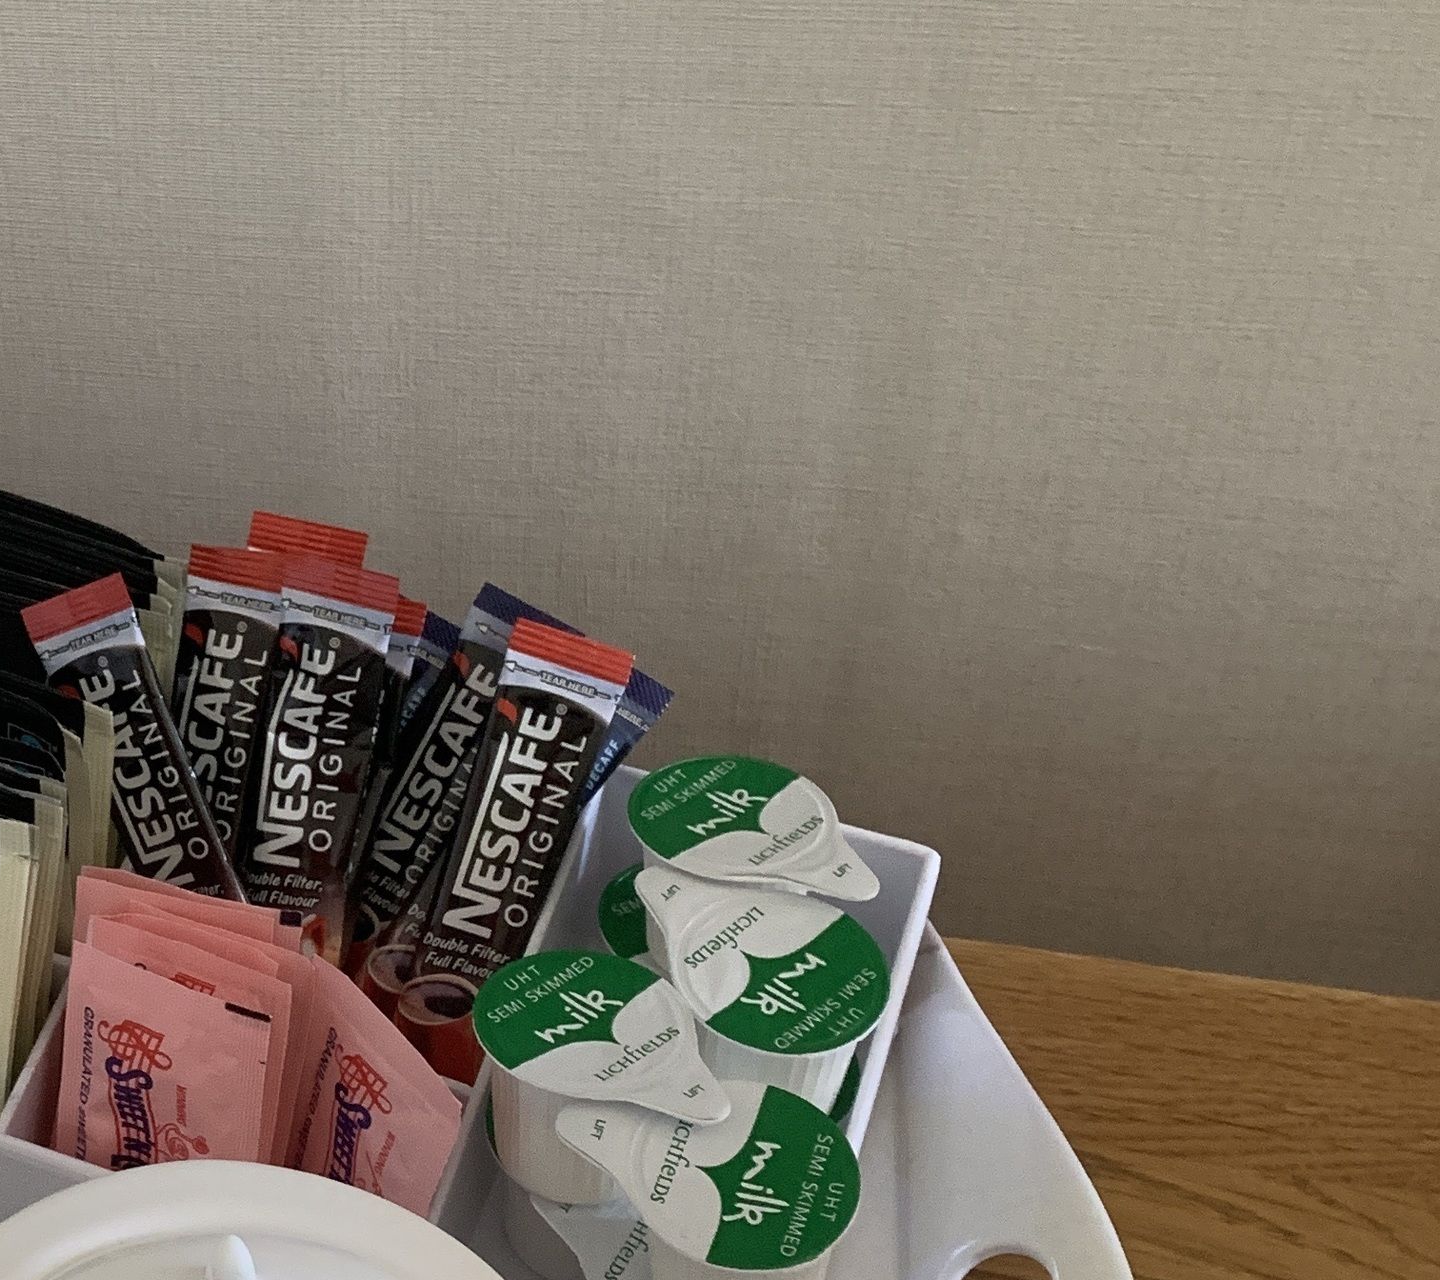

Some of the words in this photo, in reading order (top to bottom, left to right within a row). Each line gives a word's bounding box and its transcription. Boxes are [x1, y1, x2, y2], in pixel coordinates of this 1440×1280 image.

[313, 605, 339, 622] TEAR
[541, 671, 567, 689] TEAR
[121, 669, 210, 859] ORIGINAL
[308, 666, 362, 852] ORIGINAL
[586, 739, 621, 791] DECAFF
[653, 768, 688, 793] UHT
[641, 801, 676, 821] SEMI
[674, 759, 738, 803] SKIMMED
[505, 736, 588, 928] ORIGINAL
[686, 788, 770, 837] milk
[833, 862, 854, 878] LIFT
[269, 890, 320, 909] Flavour
[661, 883, 681, 902] LIFT
[423, 931, 470, 955] Double
[425, 951, 453, 970] Full
[486, 1002, 527, 1024] SEMI
[524, 955, 595, 1004] SKIMMED
[502, 964, 541, 991] UHT
[739, 952, 828, 1016] milk
[837, 967, 879, 1001] SEMI
[533, 989, 624, 1045] milk
[774, 997, 842, 1049] SKIMMED
[833, 1007, 866, 1037] UHT
[78, 1006, 96, 1106] GRANULATED
[682, 1083, 707, 1100] LIFT
[590, 1118, 607, 1141] LIFT
[808, 1132, 835, 1179] SEMI
[722, 1140, 791, 1226] milk
[818, 1181, 847, 1223] UHT
[779, 1178, 820, 1259] SKIMMED
